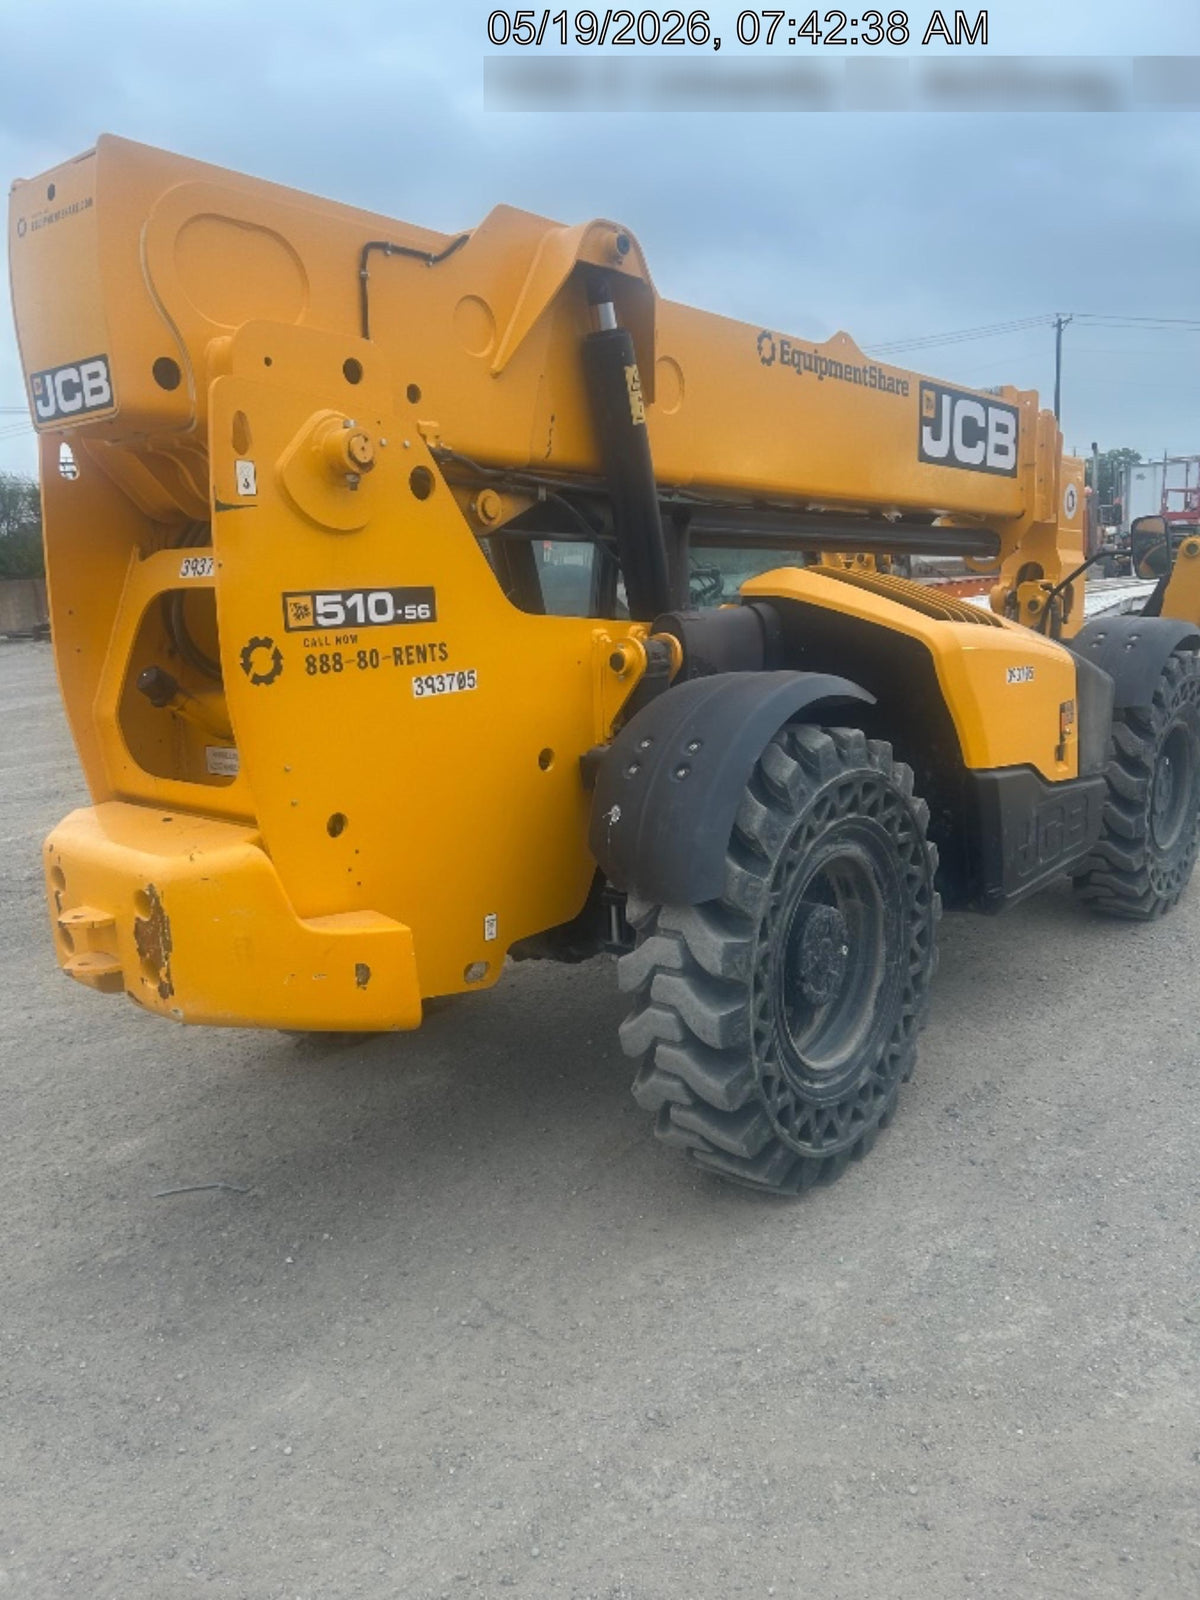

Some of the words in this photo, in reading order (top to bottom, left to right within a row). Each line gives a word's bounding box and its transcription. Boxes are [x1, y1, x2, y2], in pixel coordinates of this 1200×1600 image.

[35, 360, 111, 417] JCB
[779, 339, 910, 397] EquipmentShare
[922, 393, 1016, 470] JCB
[303, 636, 331, 648] CALL
[335, 634, 358, 645] NOW
[305, 642, 449, 676] 888-80-RENTS
[413, 670, 476, 696] 393705
